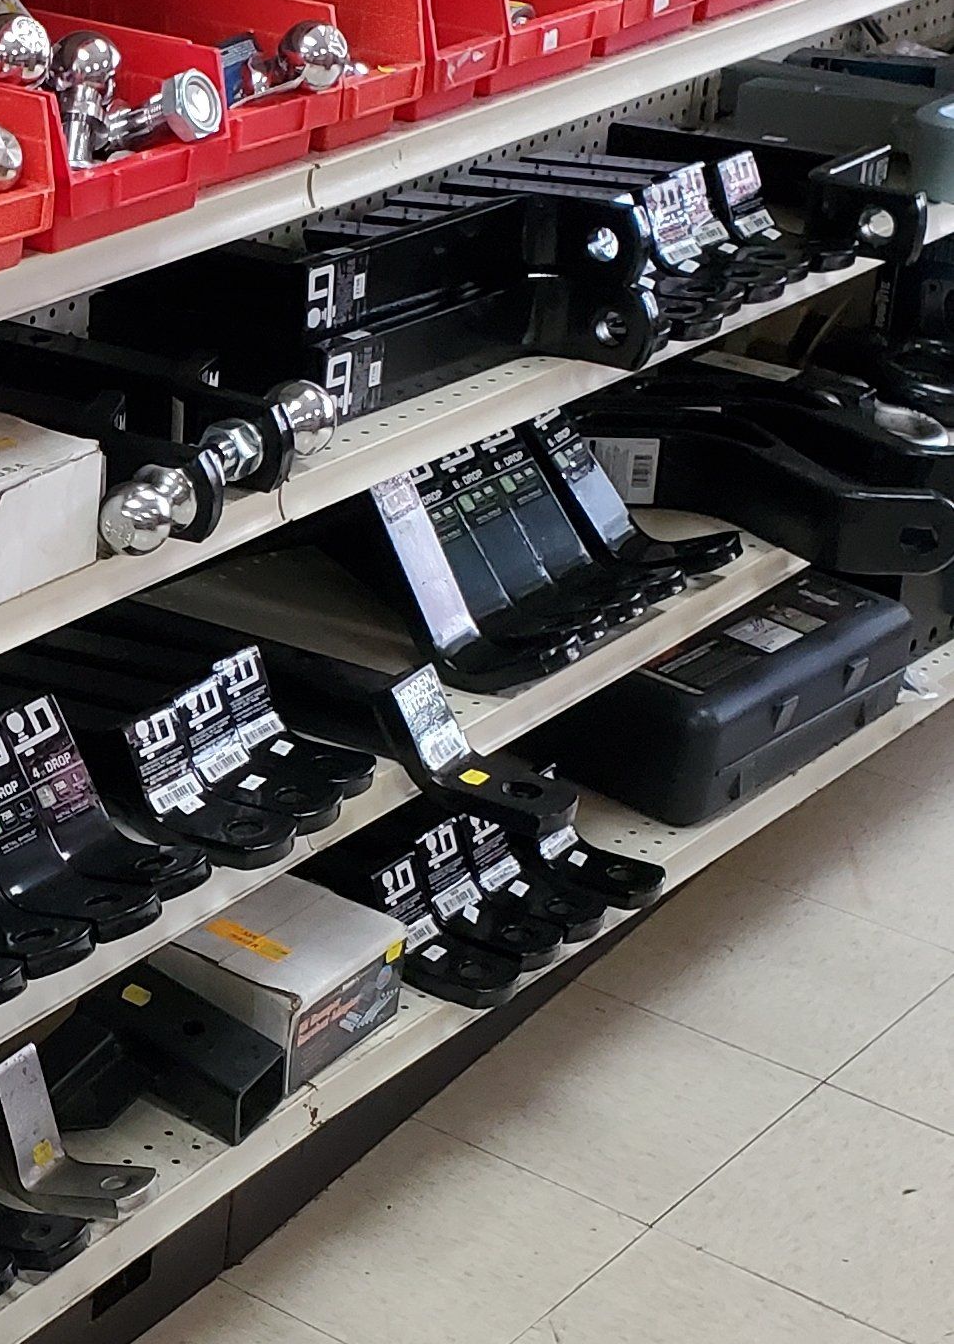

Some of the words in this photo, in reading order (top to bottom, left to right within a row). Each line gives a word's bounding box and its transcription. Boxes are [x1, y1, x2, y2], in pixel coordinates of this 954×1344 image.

[554, 427, 571, 444] DROP
[504, 450, 524, 468] DROP
[462, 469, 483, 486] DROP
[422, 489, 442, 506] DROP
[32, 766, 40, 779] 4
[45, 752, 71, 774] DROP
